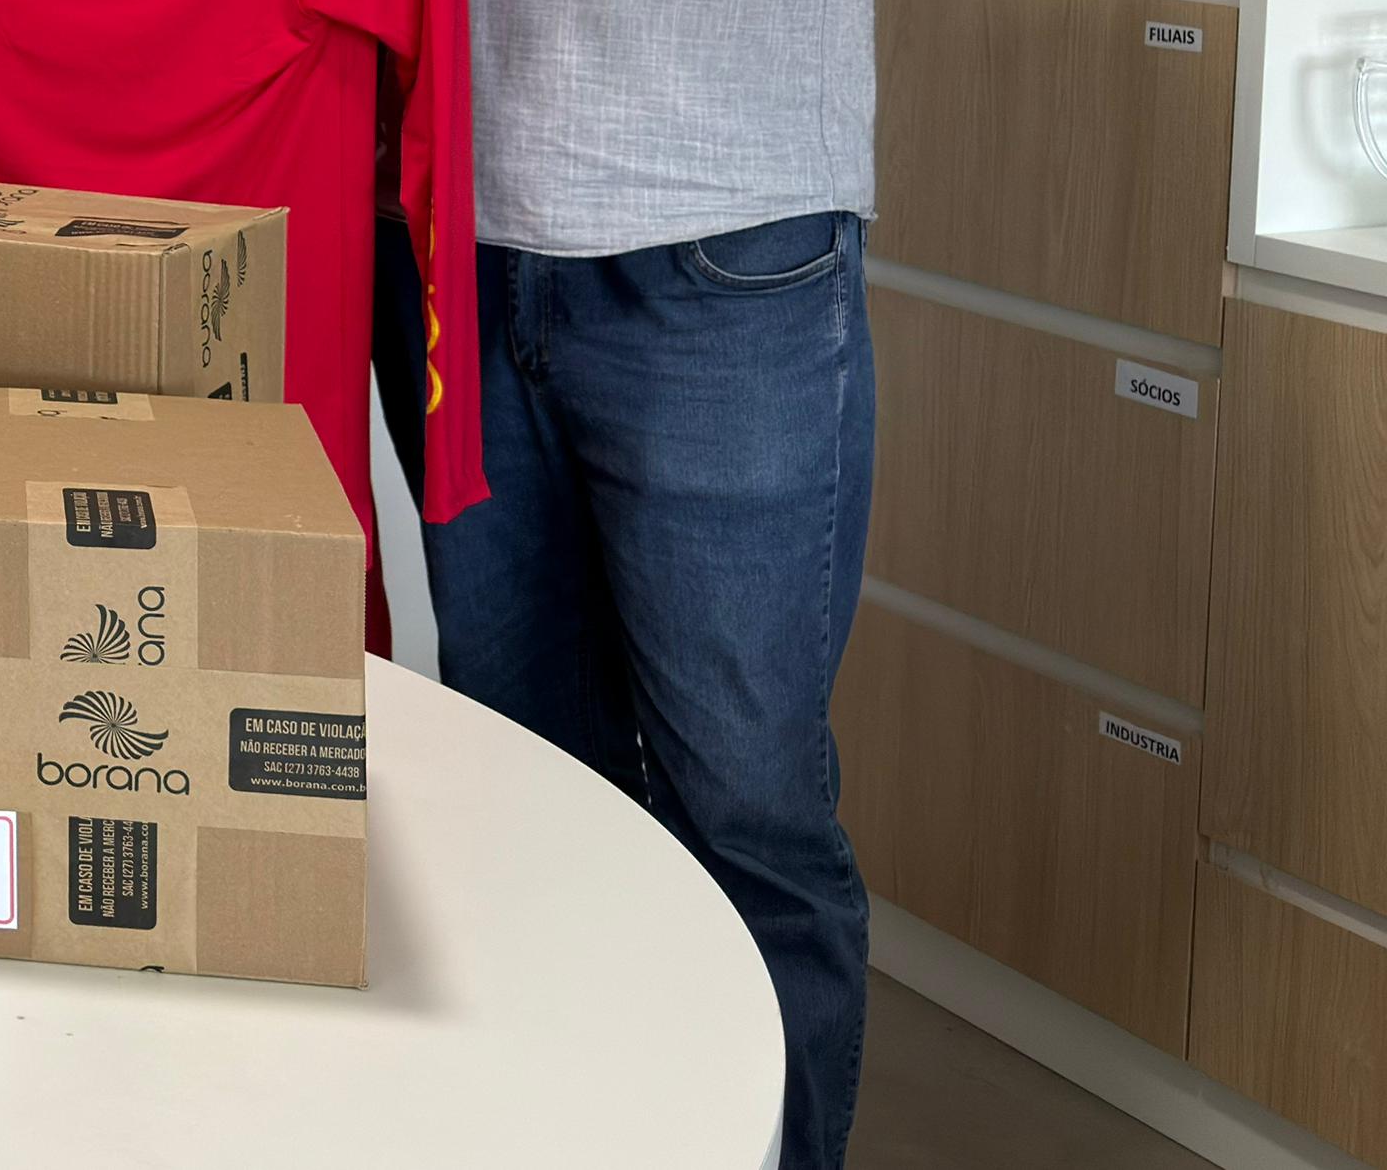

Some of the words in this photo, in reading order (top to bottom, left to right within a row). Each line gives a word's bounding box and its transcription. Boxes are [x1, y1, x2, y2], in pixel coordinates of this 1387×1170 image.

[1149, 27, 1195, 45] FILIAIS
[200, 249, 213, 368] borana
[1130, 378, 1181, 407] SÓCIOS
[245, 718, 263, 732] EM
[267, 719, 297, 735] CASO
[301, 721, 316, 736] DE
[240, 739, 261, 753] NÃO
[263, 741, 307, 756] RECEBER
[310, 746, 317, 757] A
[1106, 720, 1179, 763] INDUSTRIA
[36, 752, 190, 796] borana
[264, 761, 283, 773] SAC
[284, 762, 304, 774] (27)
[307, 764, 360, 778] 3763-4438
[79, 847, 93, 862] DE
[79, 864, 93, 892] CASO
[103, 856, 115, 897] RECEBER
[123, 861, 134, 878] (27)
[122, 879, 134, 897] SAC
[78, 895, 93, 911] EM
[101, 898, 115, 917] NÃO
